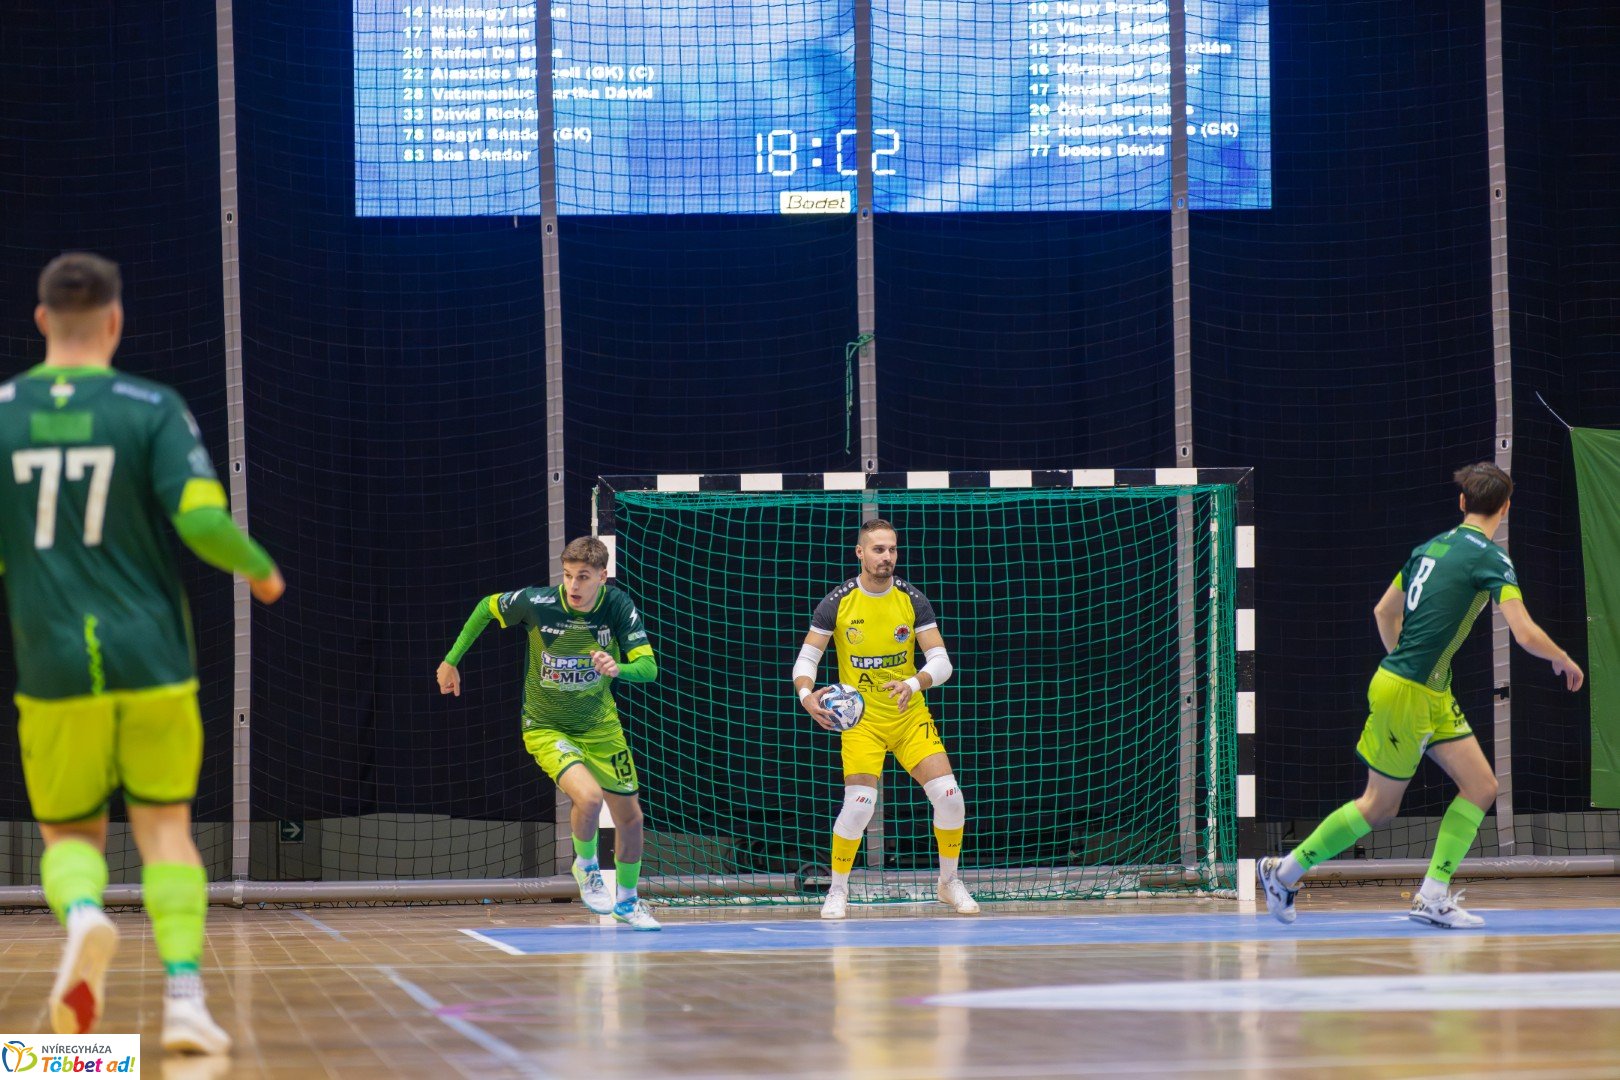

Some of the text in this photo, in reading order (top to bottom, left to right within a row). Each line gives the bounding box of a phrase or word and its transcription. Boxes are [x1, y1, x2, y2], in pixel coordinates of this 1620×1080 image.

[403, 6, 423, 18] 14
[1029, 2, 1049, 15] 10
[403, 26, 423, 39] 17
[1029, 22, 1049, 35] 13
[403, 47, 424, 60] 20
[1029, 42, 1049, 55] 15
[403, 67, 424, 80] 22
[1029, 63, 1050, 76] 16
[403, 87, 424, 100] 28
[1029, 83, 1050, 96] 17
[403, 108, 424, 121] 33
[1029, 103, 1051, 116] 20
[403, 128, 425, 141] 78
[1030, 144, 1051, 157] 77
[786, 195, 846, 209] Bodet
[11, 446, 116, 550] 77
[1406, 556, 1436, 612] 8
[610, 749, 632, 780] 13
